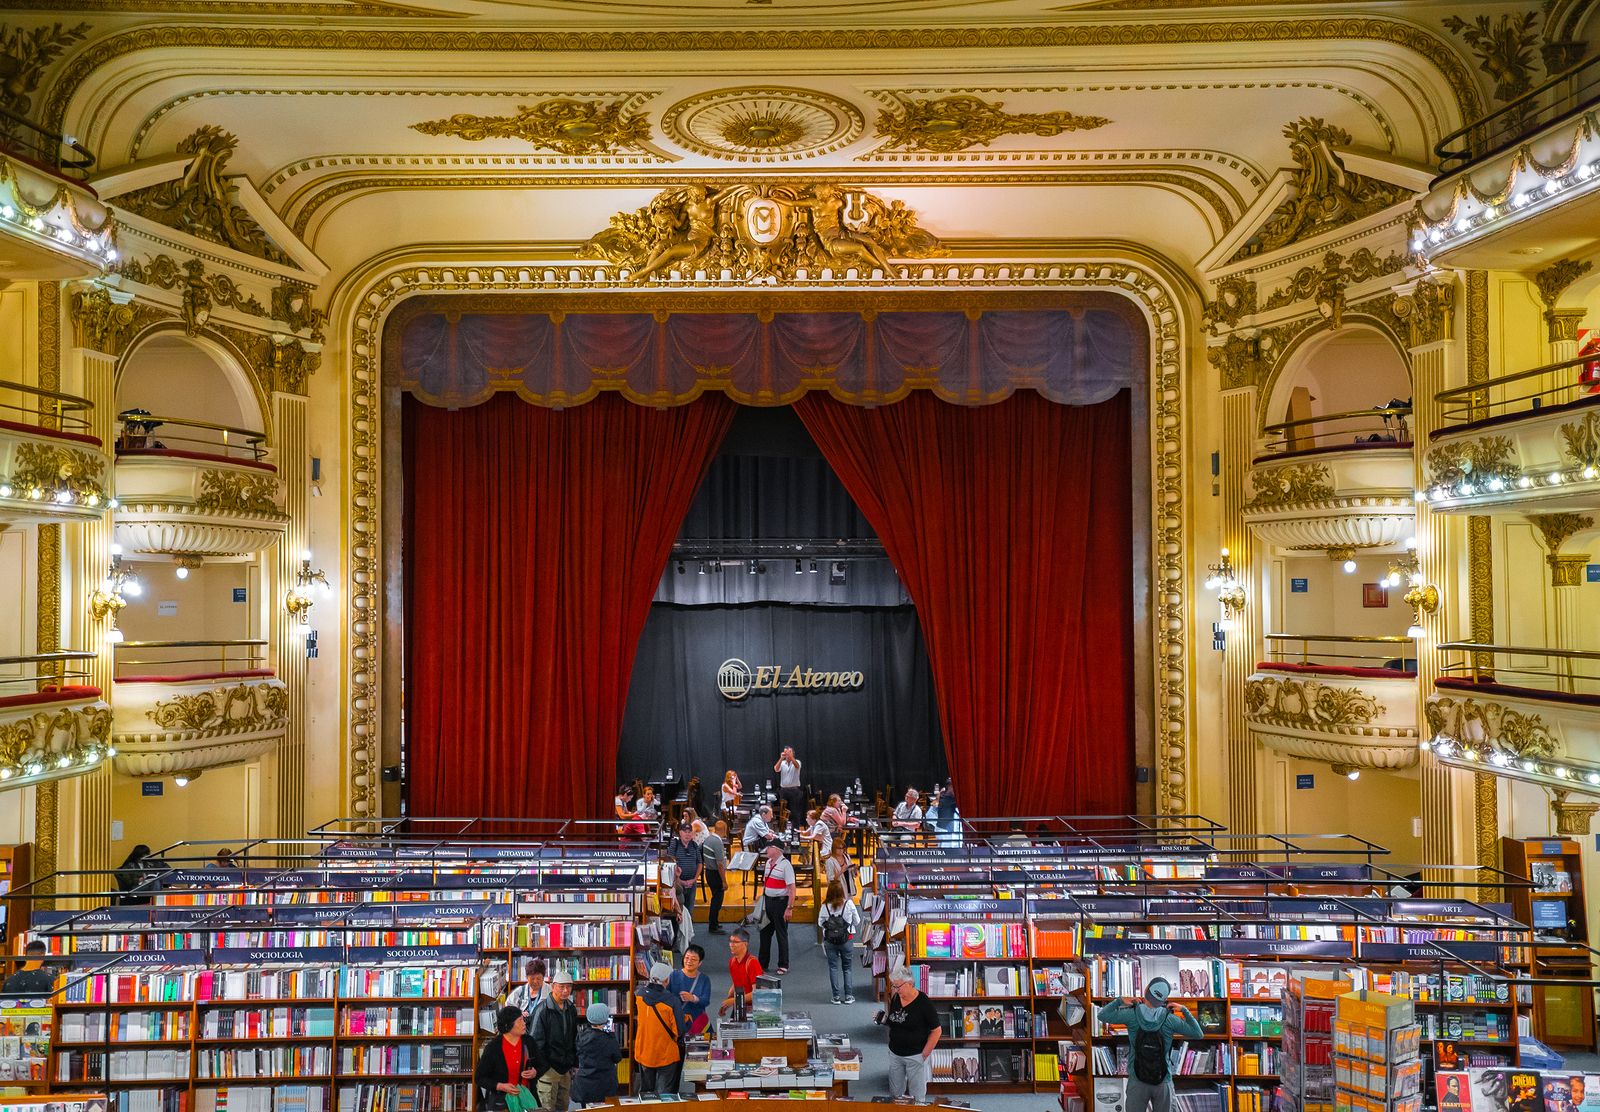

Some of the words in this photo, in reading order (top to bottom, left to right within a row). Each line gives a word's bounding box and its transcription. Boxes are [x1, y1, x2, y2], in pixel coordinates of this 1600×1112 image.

[752, 665, 782, 689] El
[783, 664, 865, 689] Ateneo
[175, 874, 231, 882] ANTROPOLOGIA
[434, 907, 474, 915] FILOSOFIA
[933, 903, 953, 911] ARTE
[953, 903, 999, 911] ARGENTINO
[1077, 903, 1097, 911] RTE
[190, 911, 231, 919] FILOFIA
[1267, 943, 1308, 952] TURISMO
[250, 951, 304, 959] SOCIOLOGIA
[386, 949, 440, 958] SOCIOLOGIA
[1512, 1075, 1537, 1087] CINEMA
